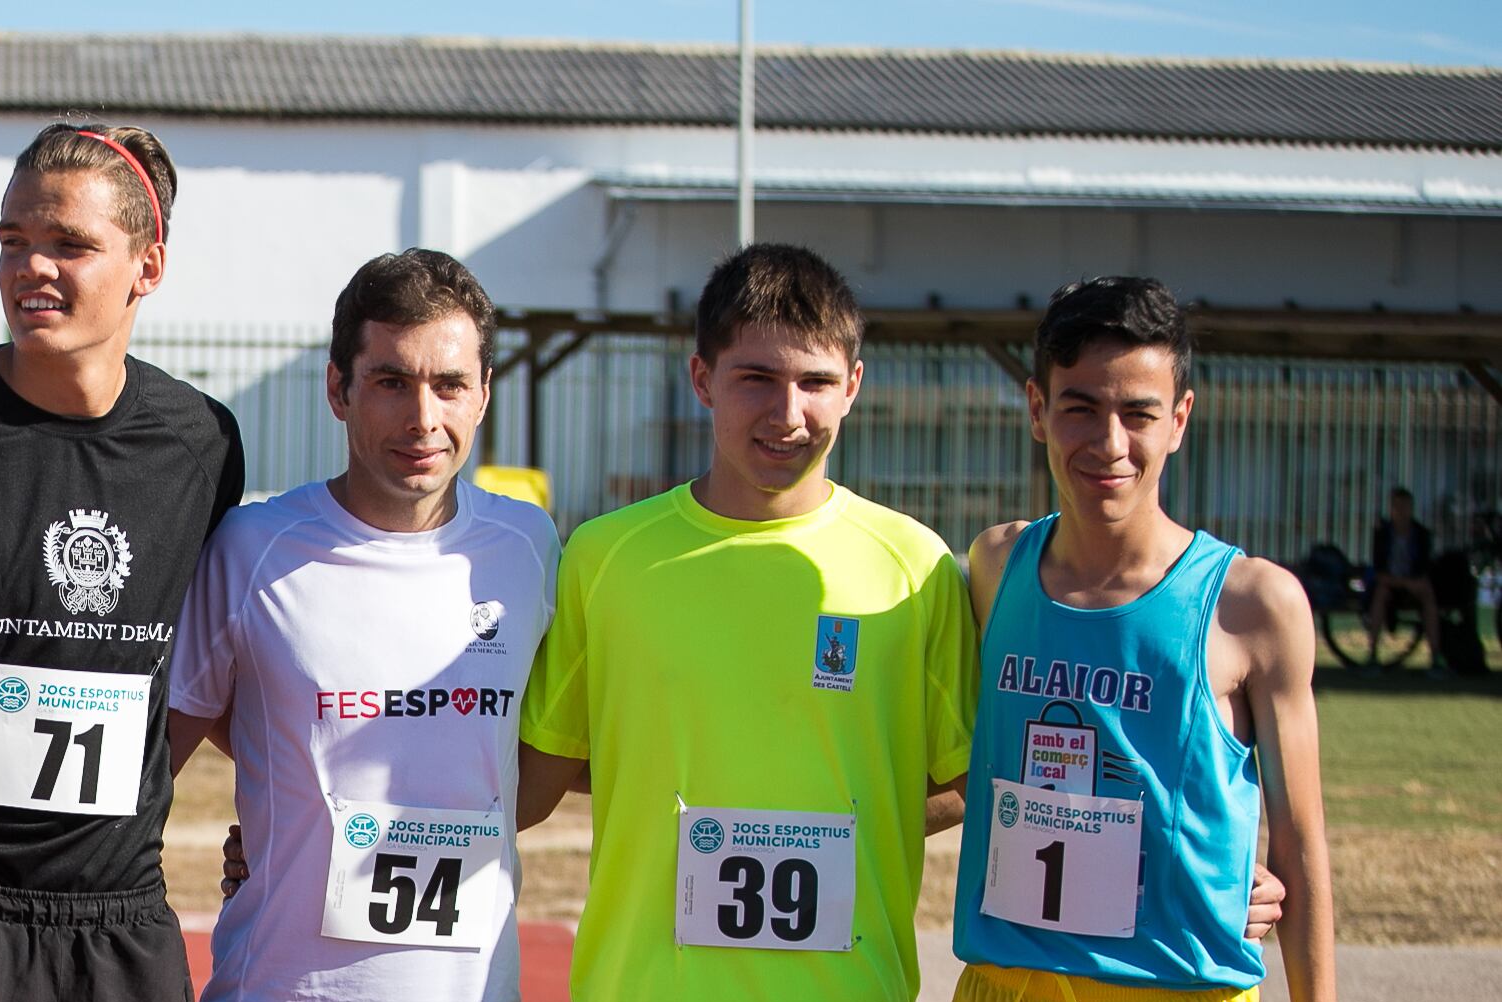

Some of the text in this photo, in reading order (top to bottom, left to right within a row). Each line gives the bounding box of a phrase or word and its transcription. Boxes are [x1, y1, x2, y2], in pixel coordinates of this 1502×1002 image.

[39, 684, 144, 701] JOCS ESPORTIUS
[998, 654, 1154, 713] ALAIOR
[38, 696, 119, 712] MUNICIPALS
[1033, 733, 1085, 750] amb el
[31, 718, 105, 804] 71
[1032, 749, 1089, 770] comerç
[1031, 761, 1066, 779] local
[1024, 800, 1136, 824] JOCS ESPORTIUS
[388, 820, 500, 837] JOCS ESPORTIUS
[732, 823, 850, 839] JOCS ESPORTIUS
[1024, 812, 1102, 834] MUNICIPALS
[387, 832, 470, 847] MUNICIPALS
[732, 835, 820, 849] MUNICIPALS
[1035, 840, 1065, 922] 1
[368, 852, 463, 937] 54
[717, 856, 818, 942] 39
